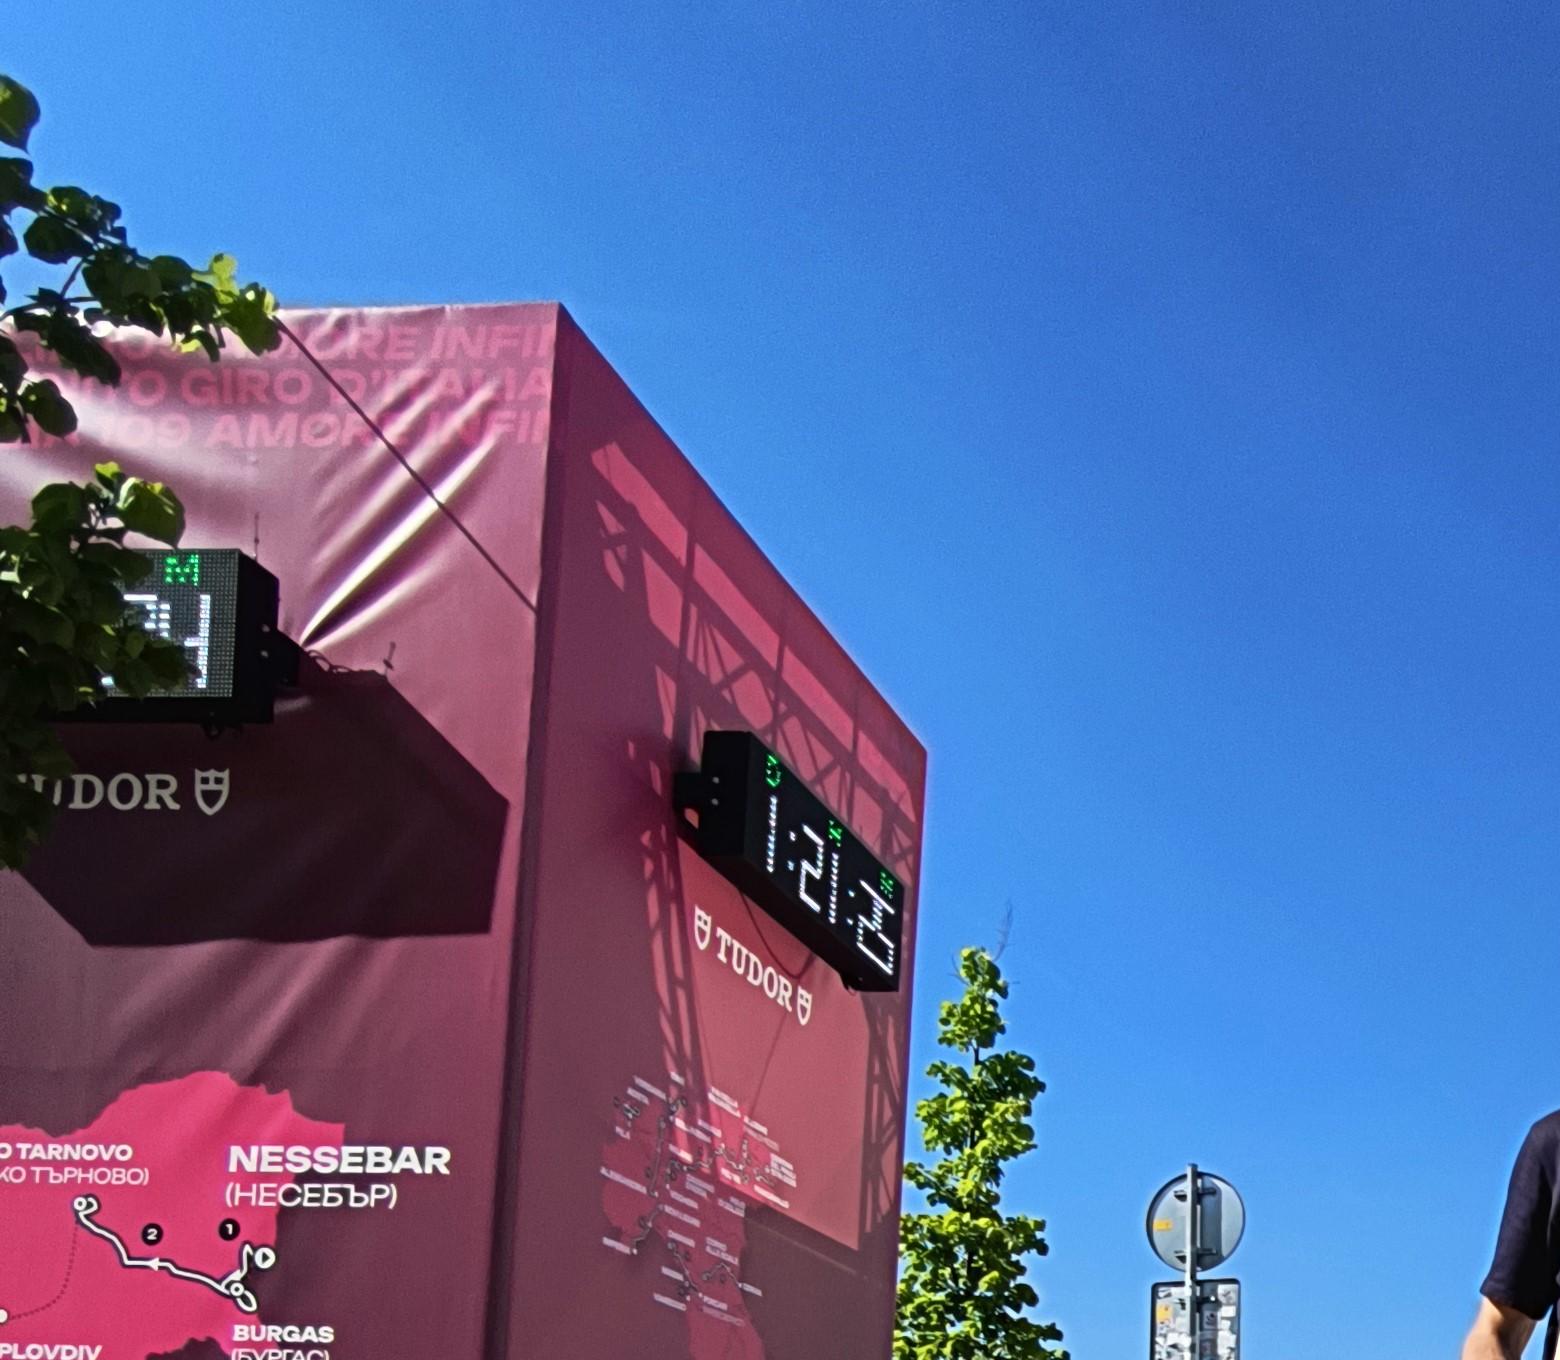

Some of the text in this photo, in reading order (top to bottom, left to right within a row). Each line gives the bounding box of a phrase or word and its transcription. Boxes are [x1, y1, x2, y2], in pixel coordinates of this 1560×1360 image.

[180, 367, 313, 407] GIRO
[17, 772, 181, 811] UDOR
[715, 926, 793, 1013] TUDOR
[15, 1143, 133, 1162] TARNOVO
[228, 1145, 451, 1175] NESSEBAR
[30, 1166, 149, 1186] ТЪРНОВО)
[225, 1182, 398, 1210] (НЕСЕБЪР)
[146, 1228, 158, 1240] 2
[225, 1223, 233, 1236] 1
[232, 1324, 335, 1344] BURGAS
